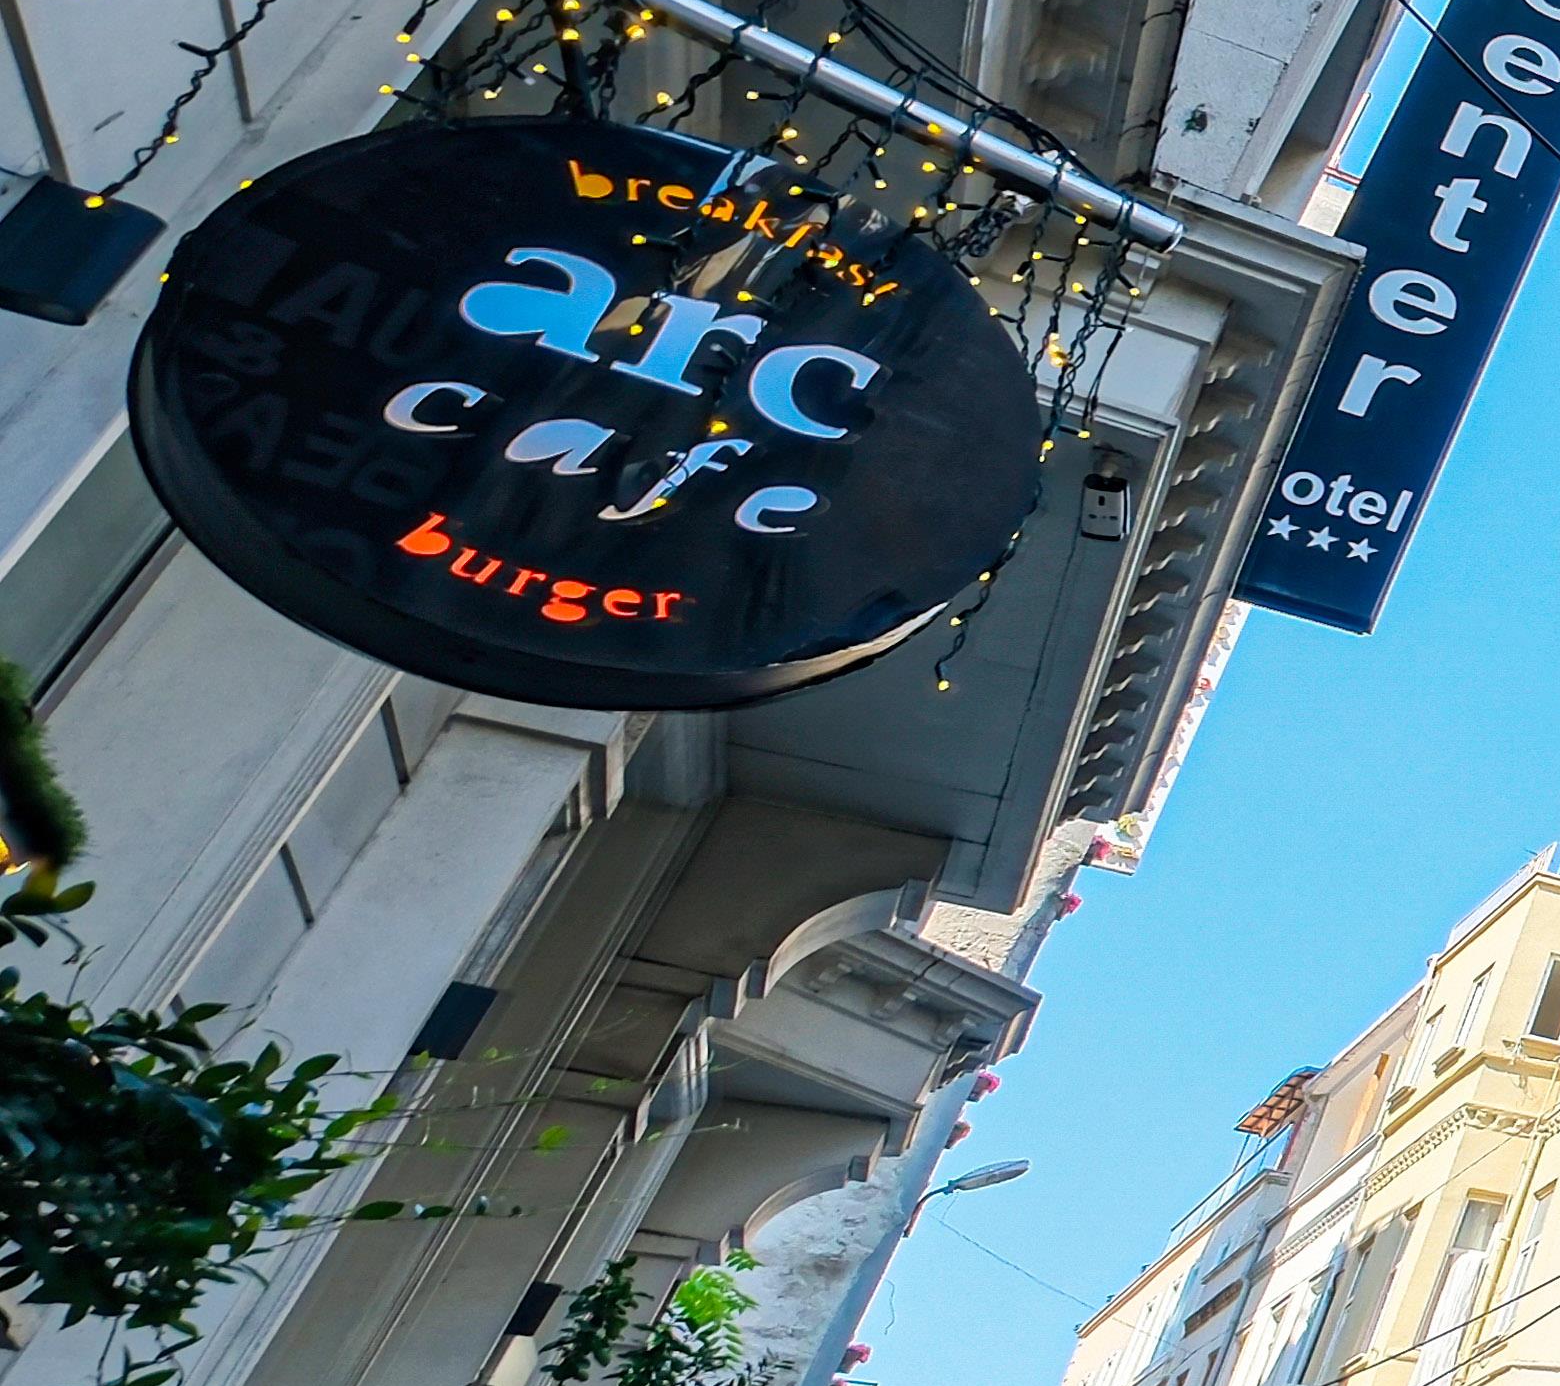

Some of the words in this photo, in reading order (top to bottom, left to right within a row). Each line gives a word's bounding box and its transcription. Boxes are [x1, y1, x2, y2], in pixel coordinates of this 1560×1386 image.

[459, 244, 881, 441] arc
[382, 379, 819, 535] cafe
[1280, 467, 1413, 534] otel
[395, 510, 683, 623] burger
